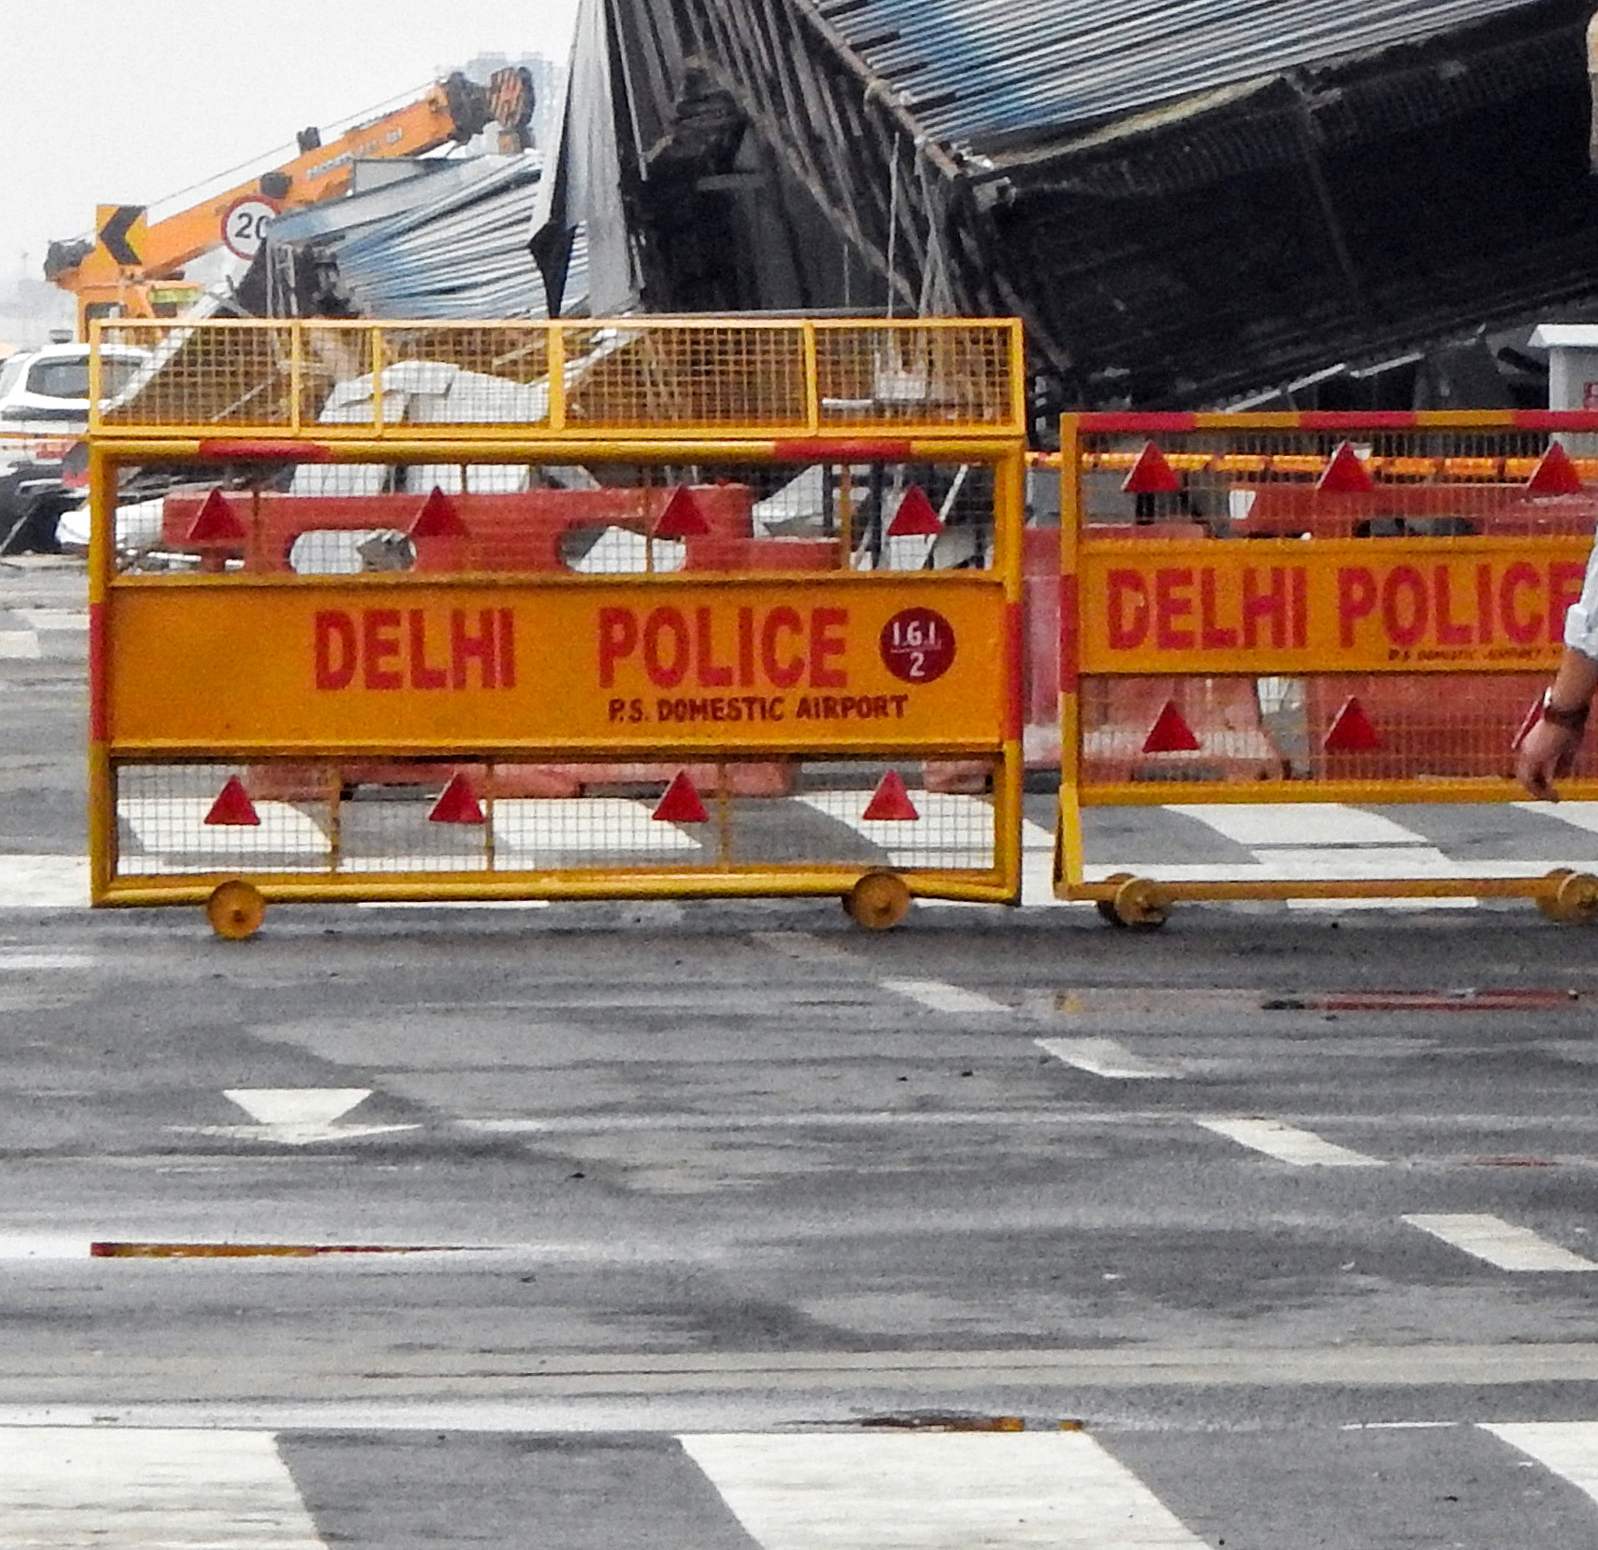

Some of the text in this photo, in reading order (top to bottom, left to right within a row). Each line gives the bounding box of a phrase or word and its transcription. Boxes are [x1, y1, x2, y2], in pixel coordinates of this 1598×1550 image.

[1107, 567, 1307, 650] DELHI
[315, 607, 847, 689] DELHI POLICE
[909, 651, 925, 677] 2
[657, 696, 784, 722] DOMESTIC
[796, 694, 908, 719] AIRPORT
